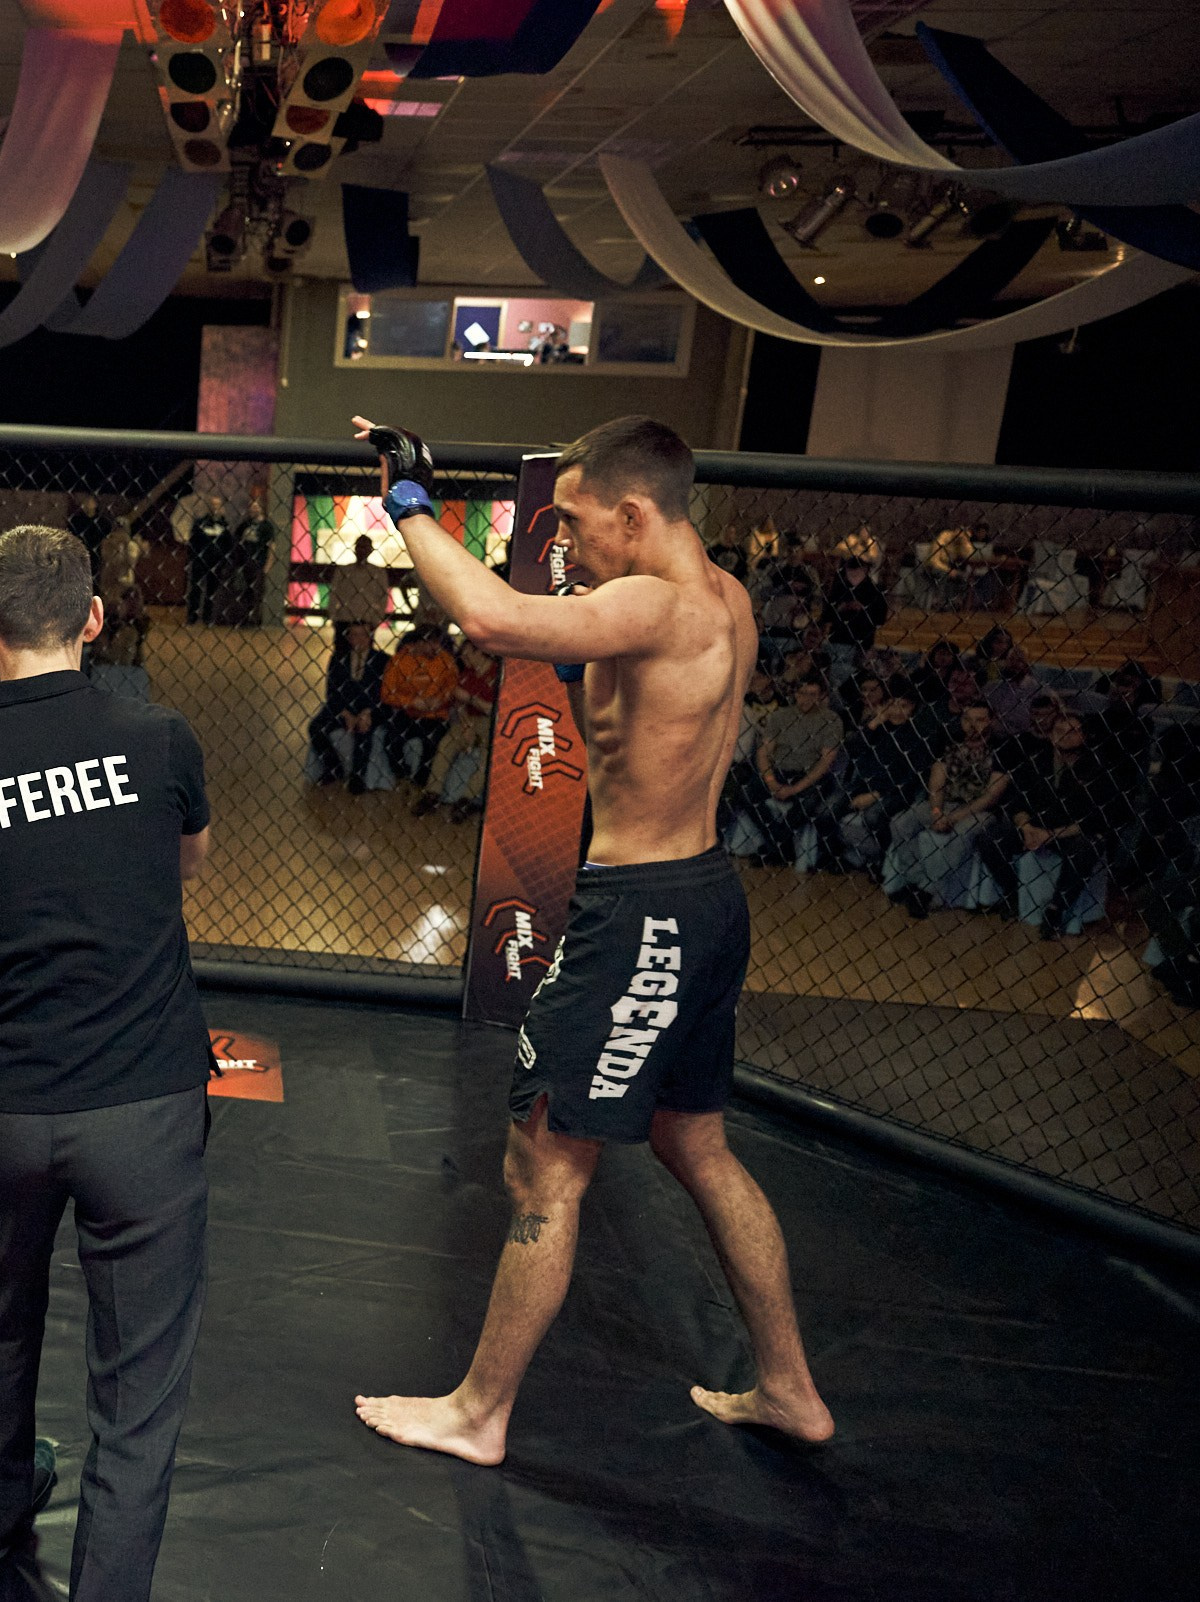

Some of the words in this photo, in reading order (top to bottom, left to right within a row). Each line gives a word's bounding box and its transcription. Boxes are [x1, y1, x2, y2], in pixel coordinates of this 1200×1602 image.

[536, 717, 555, 757] MIX
[527, 748, 544, 790] FIGHT
[514, 910, 534, 949] MIX
[505, 940, 522, 980] FIGHT
[588, 917, 683, 1100] LEGENDA
